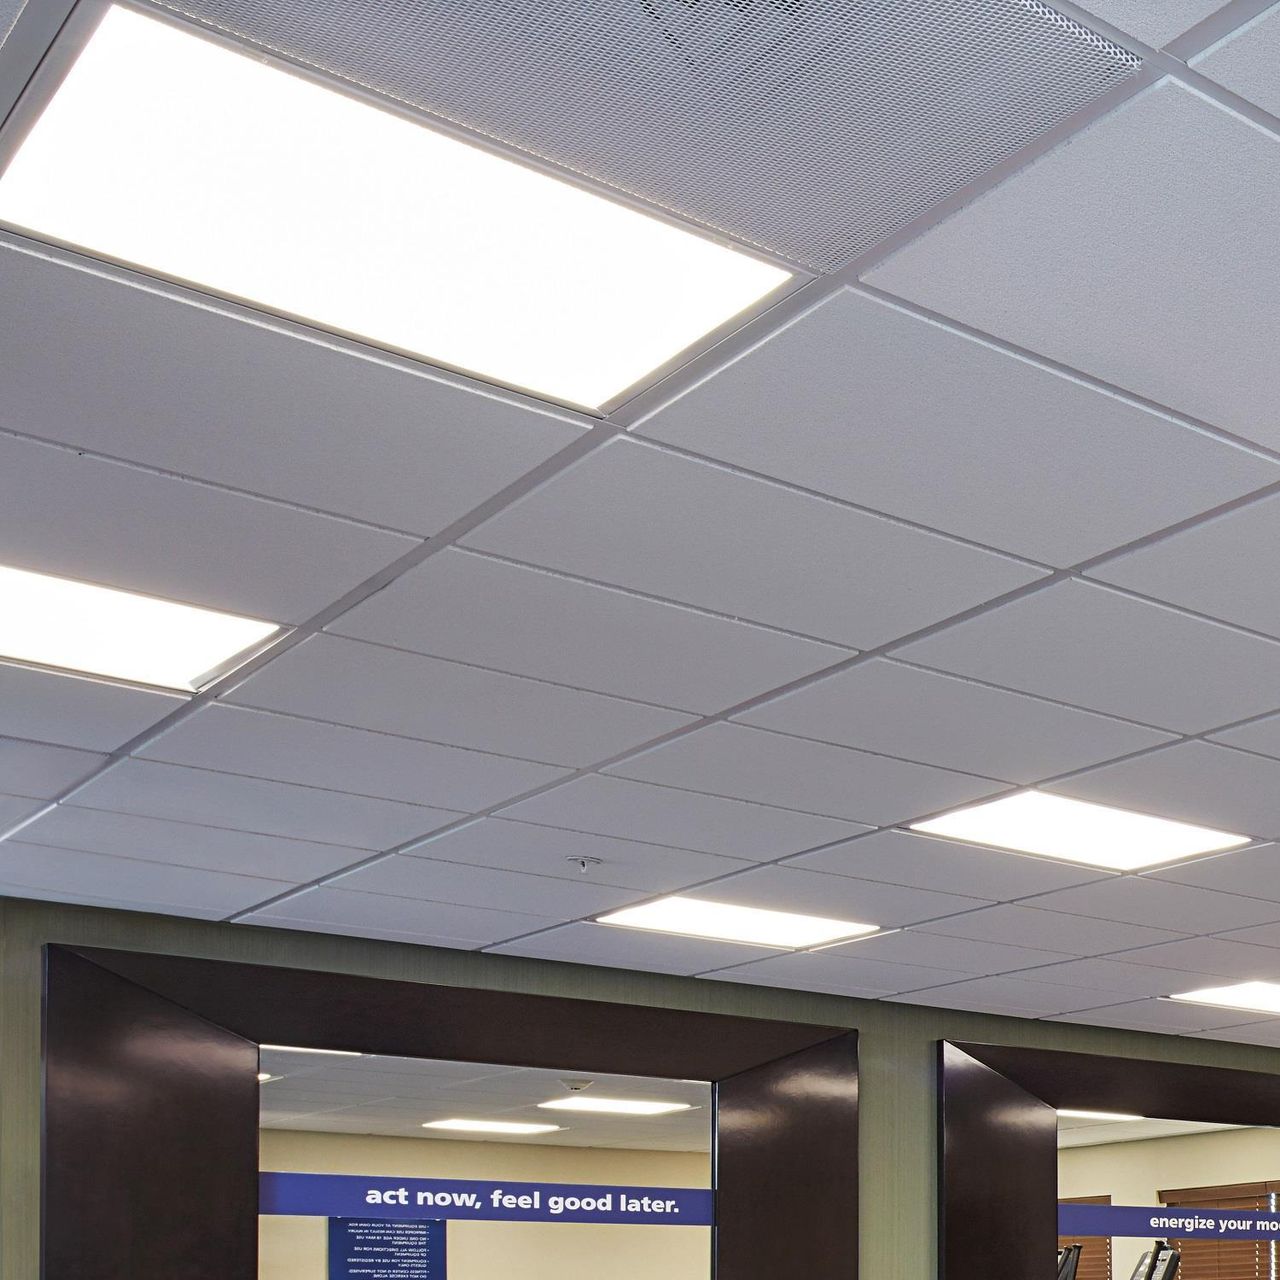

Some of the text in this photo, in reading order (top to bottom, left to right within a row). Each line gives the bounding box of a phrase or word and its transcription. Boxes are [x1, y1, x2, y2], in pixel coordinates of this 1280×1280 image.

[365, 1187, 679, 1214] act now, feel good later.
[1150, 1215, 1215, 1232] energize
[1219, 1219, 1253, 1233] your
